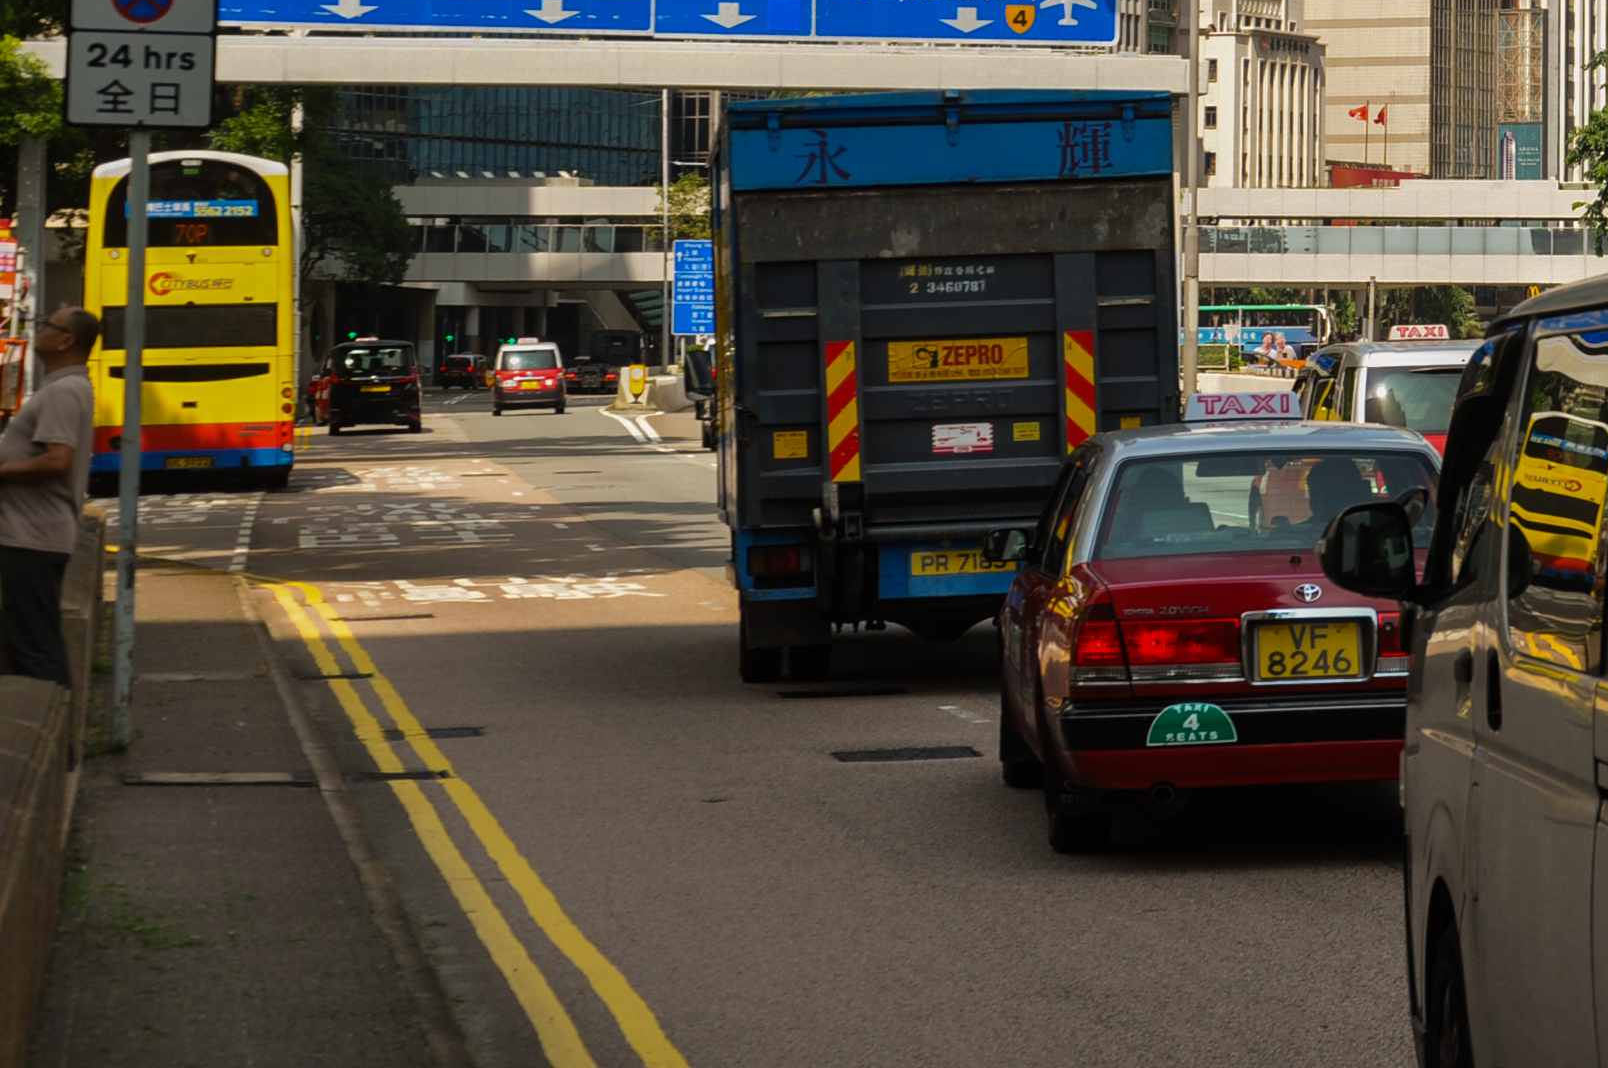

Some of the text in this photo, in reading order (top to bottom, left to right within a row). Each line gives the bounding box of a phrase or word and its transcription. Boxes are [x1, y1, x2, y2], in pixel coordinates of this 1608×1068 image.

[1012, 10, 1028, 28] 4
[87, 43, 195, 70] 24 hrs
[96, 79, 180, 115] 全日
[795, 129, 851, 185] 永
[175, 224, 208, 243] 70P
[161, 279, 210, 288] CITYBUS
[909, 283, 919, 293] 2
[1396, 326, 1444, 337] TAXI
[942, 344, 1003, 366] ZEPRO
[1197, 394, 1290, 415] TAXI
[921, 554, 949, 572] PR
[1288, 624, 1330, 650] VF
[1267, 649, 1352, 676] 8246
[1173, 703, 1210, 714] TAXI
[1183, 713, 1200, 730] 4
[1166, 731, 1218, 742] SEATS
